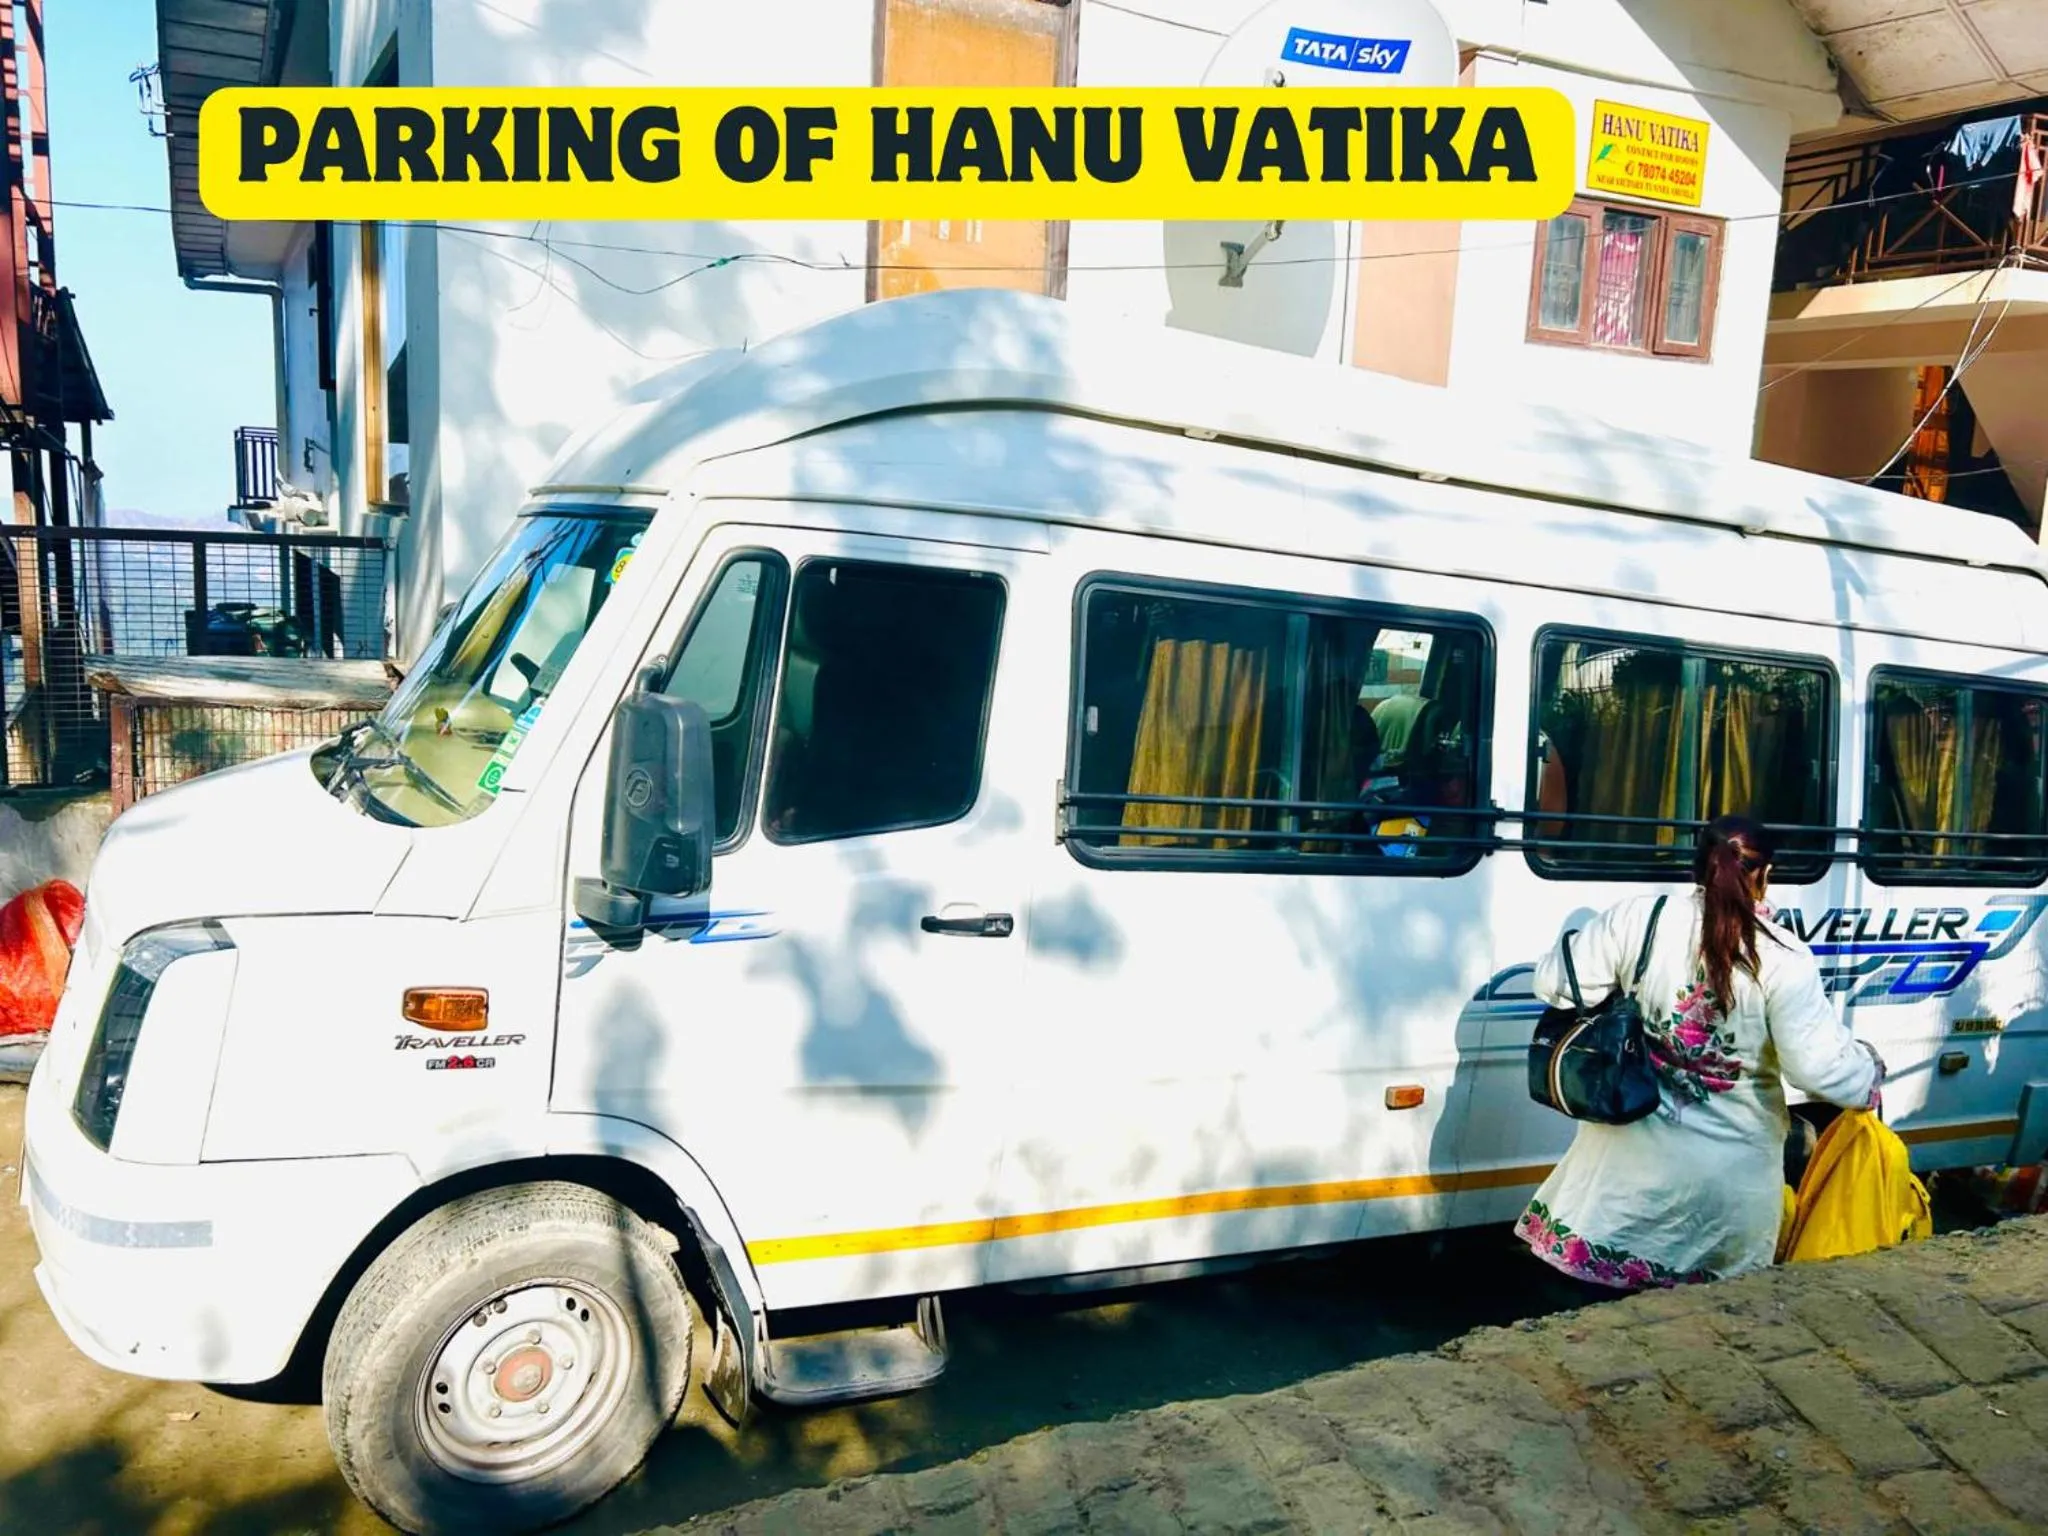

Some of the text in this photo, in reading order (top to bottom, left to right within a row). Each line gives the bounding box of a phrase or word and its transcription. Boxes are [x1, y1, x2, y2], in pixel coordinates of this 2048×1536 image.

[1294, 38, 1400, 69] TATA sky
[1602, 113, 1699, 152] HANU VATIKA
[1637, 162, 1697, 186] 78074 45204
[394, 1034, 526, 1050] TRAVELLER
